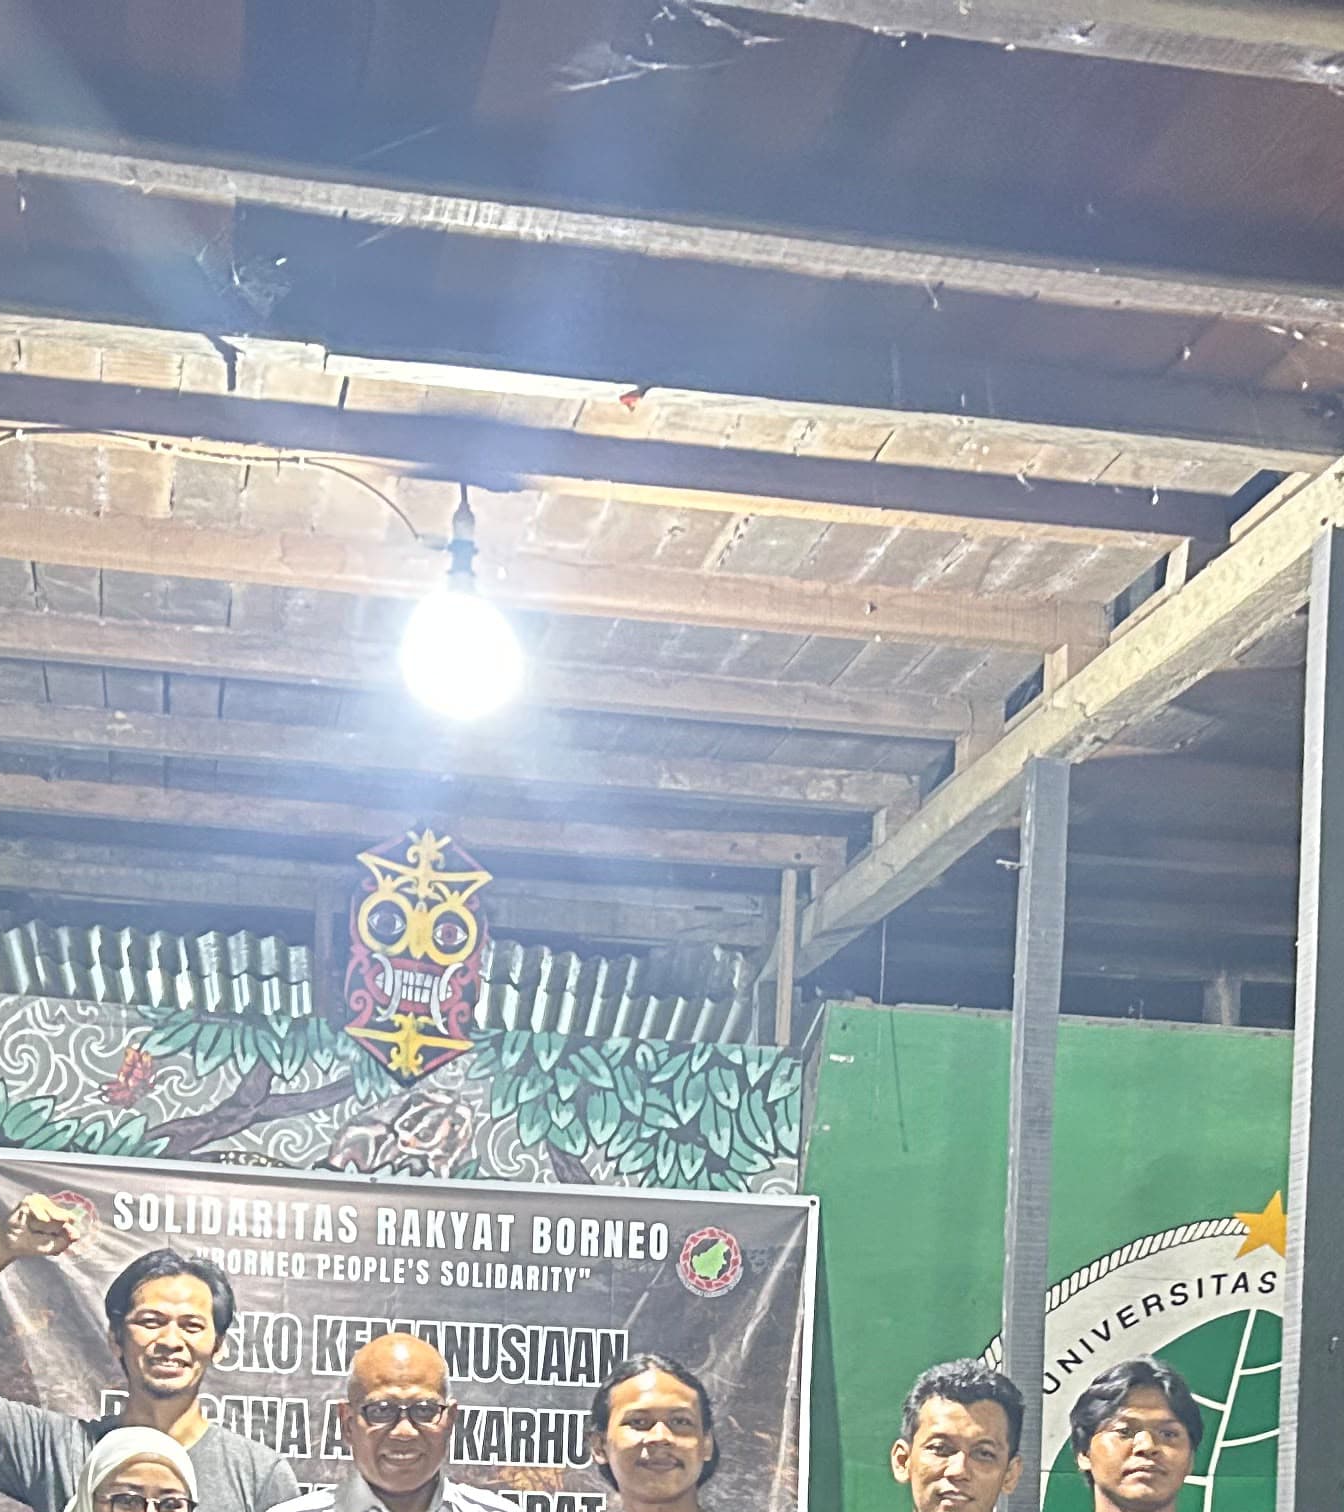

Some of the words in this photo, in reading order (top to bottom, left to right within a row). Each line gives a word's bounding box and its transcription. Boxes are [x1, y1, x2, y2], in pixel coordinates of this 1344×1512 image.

[113, 1191, 358, 1244] SOLIDARITAS
[376, 1206, 515, 1253] RAKYAT
[532, 1215, 669, 1261] BORNEO
[317, 1253, 430, 1285] PEOPLE'S
[440, 1264, 592, 1294] SOLIDARITY"
[1042, 1270, 1278, 1395] UNIVERSITAS
